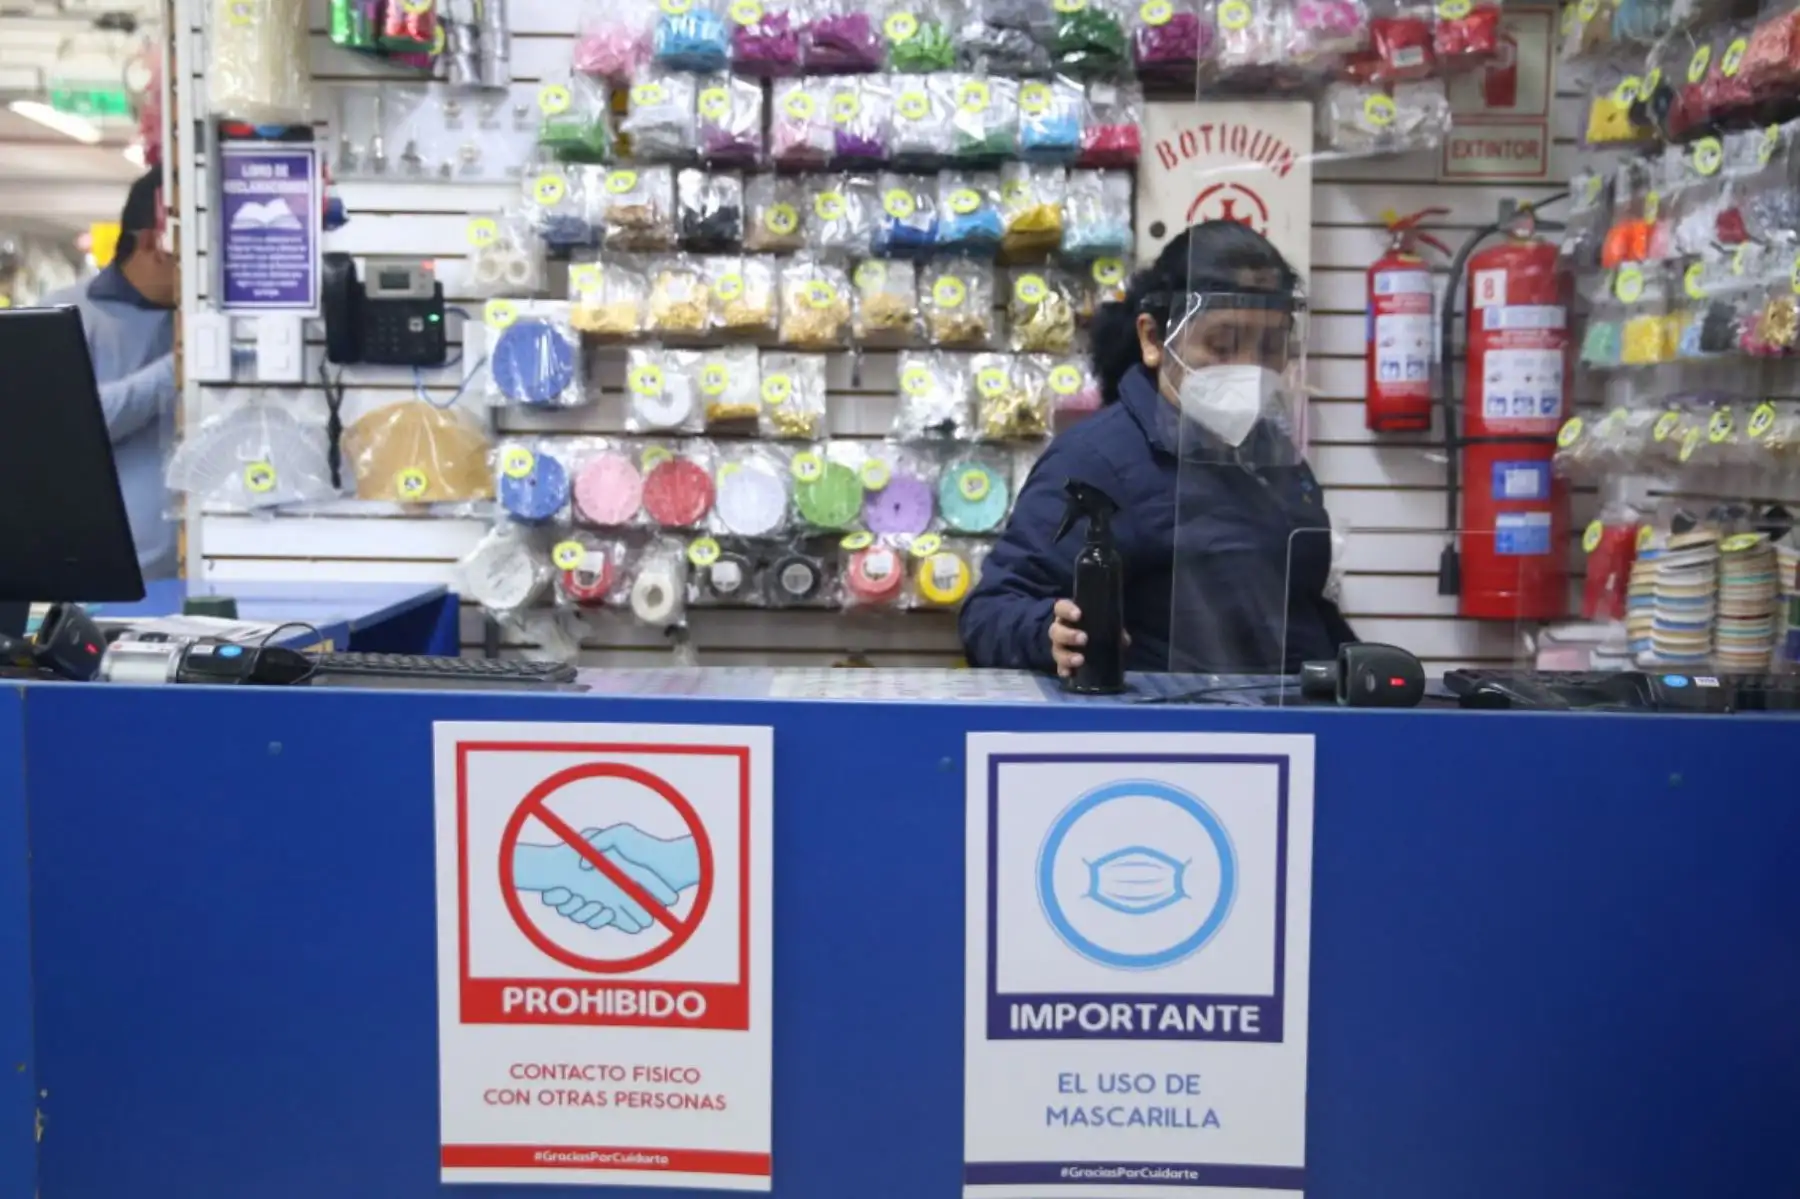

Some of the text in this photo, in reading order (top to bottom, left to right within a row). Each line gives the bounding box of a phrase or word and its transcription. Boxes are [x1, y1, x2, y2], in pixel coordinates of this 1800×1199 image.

[1155, 123, 1295, 178] BOTIQUIN
[1452, 139, 1539, 160] EXTINTOR
[502, 986, 708, 1019] PROHIBIDO
[1010, 1003, 1261, 1034] IMPORTANTE
[509, 1063, 701, 1085] CONTACTO FISICO
[1058, 1073, 1201, 1095] EL USO DE
[483, 1088, 726, 1111] CON OTRAS PERSONAS
[1046, 1106, 1220, 1128] MASCARILLA
[534, 1150, 669, 1166] #GraciasPorCuidarte
[1061, 1166, 1198, 1180] #GraciasPorCuidarte
